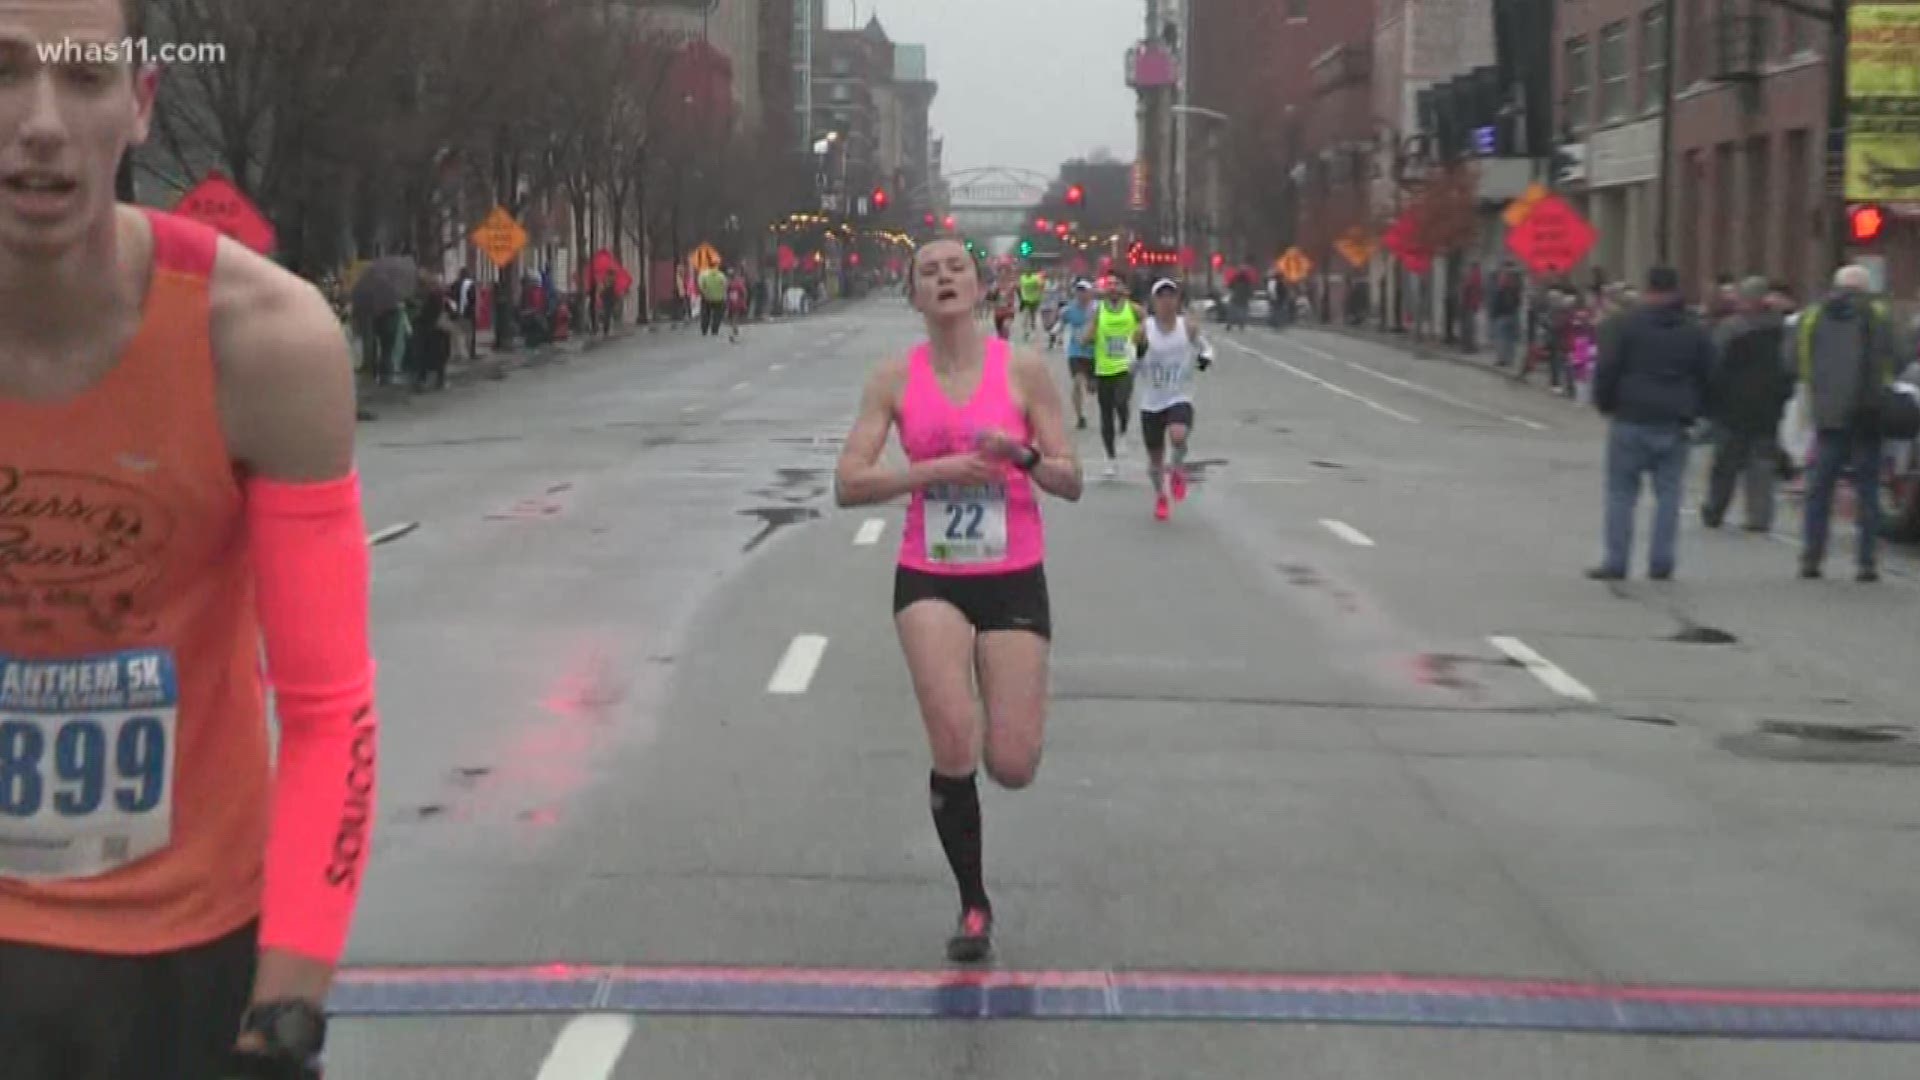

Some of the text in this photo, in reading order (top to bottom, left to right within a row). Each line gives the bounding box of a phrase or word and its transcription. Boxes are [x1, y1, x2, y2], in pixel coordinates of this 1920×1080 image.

[946, 503, 984, 539] 22
[2, 655, 160, 694] ANTHEM 5K
[0, 716, 165, 817] 899
